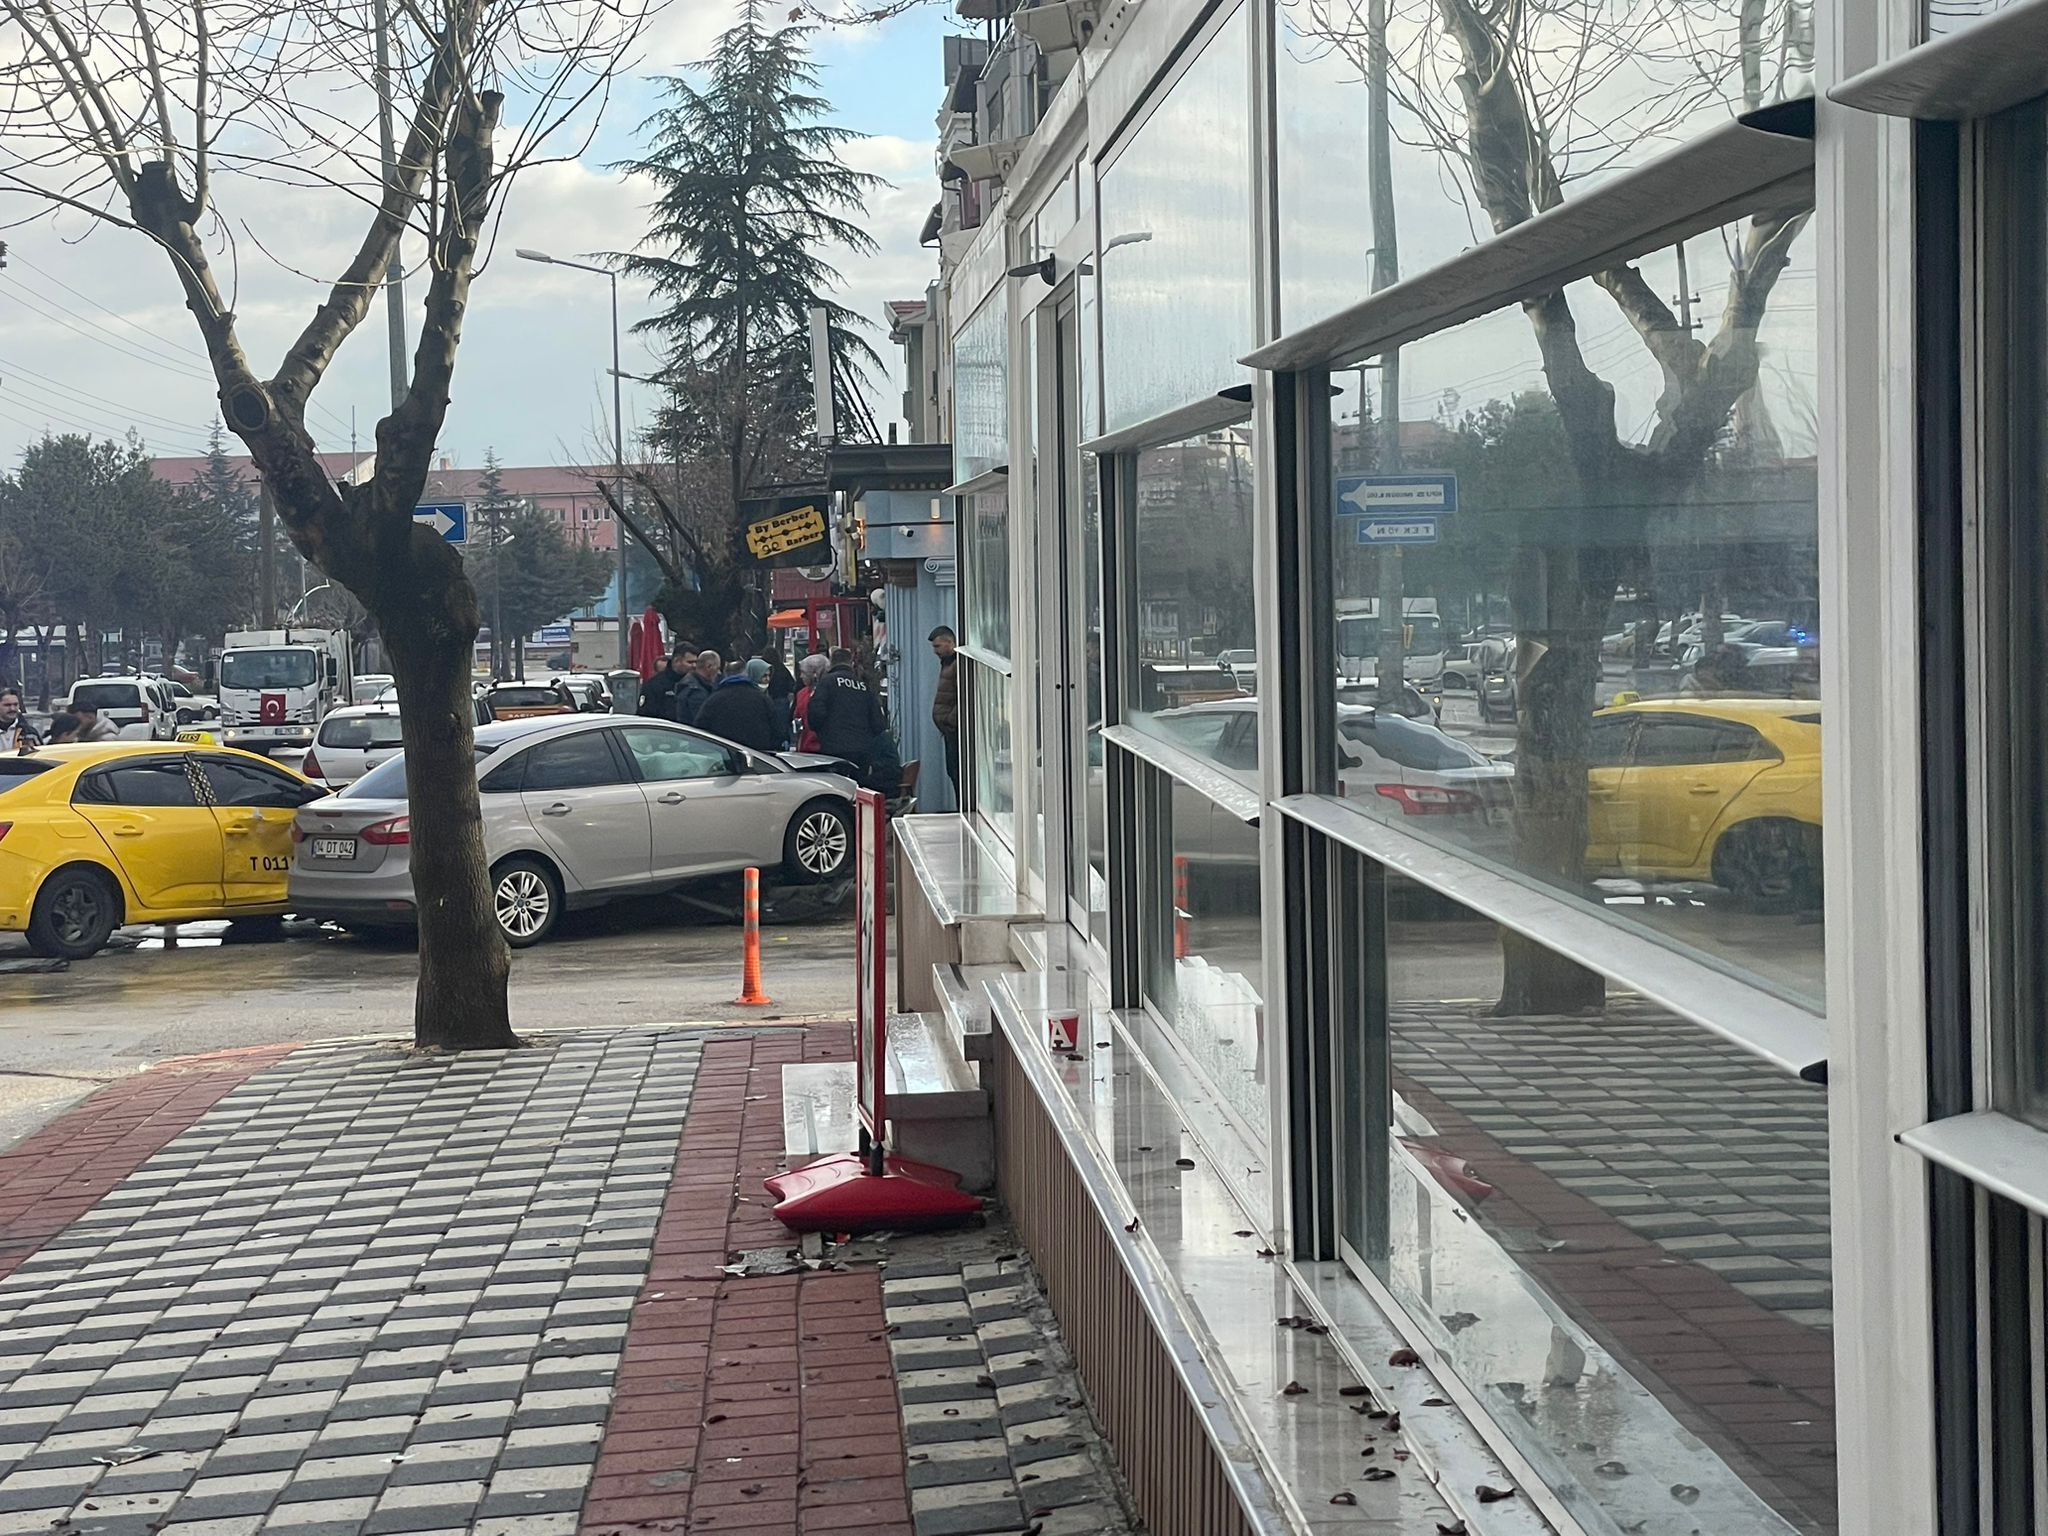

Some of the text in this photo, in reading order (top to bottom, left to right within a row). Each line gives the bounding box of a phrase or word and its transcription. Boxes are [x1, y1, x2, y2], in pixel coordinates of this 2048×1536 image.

[772, 511, 811, 528] Berber
[786, 531, 820, 546] Barber
[316, 841, 354, 854] 14 DT 042
[250, 856, 295, 871] T 011
[1051, 1020, 1074, 1048] A
